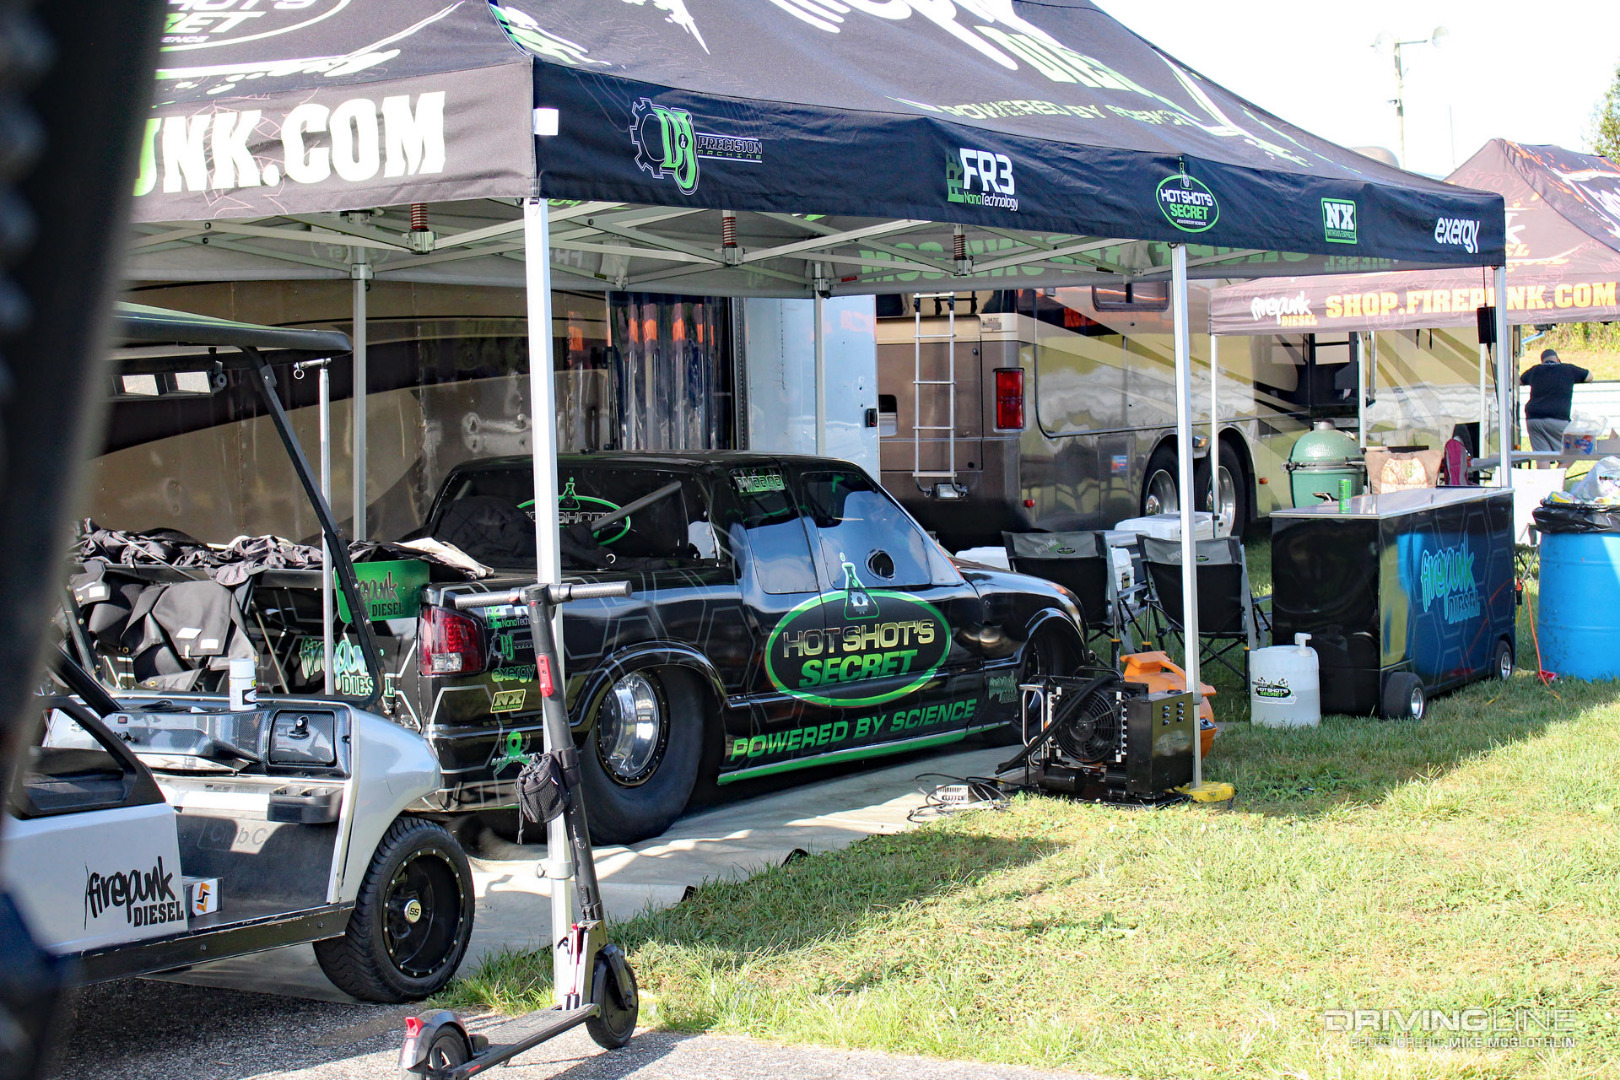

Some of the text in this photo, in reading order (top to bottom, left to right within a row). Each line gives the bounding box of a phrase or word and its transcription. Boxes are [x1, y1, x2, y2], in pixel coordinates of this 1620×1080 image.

[697, 135, 763, 155] PRECISION
[697, 149, 762, 160] MACHINE
[959, 147, 1015, 196] FR3
[963, 190, 1019, 212] NanoTechnology
[1169, 203, 1209, 220] SECRET
[1324, 202, 1355, 231] NX
[1434, 217, 1480, 254] exergy
[1280, 314, 1318, 327] DIESEL
[372, 602, 404, 618] DIESEL
[1447, 589, 1481, 625] DIESEL
[491, 664, 536, 684] exergy
[799, 649, 919, 688] SECRET
[340, 674, 396, 697] DIESL
[729, 698, 977, 762] POWERED BY SCIENCE
[84, 855, 178, 924] firepunk
[133, 900, 185, 928] DIESEL
[409, 907, 420, 916] SS
